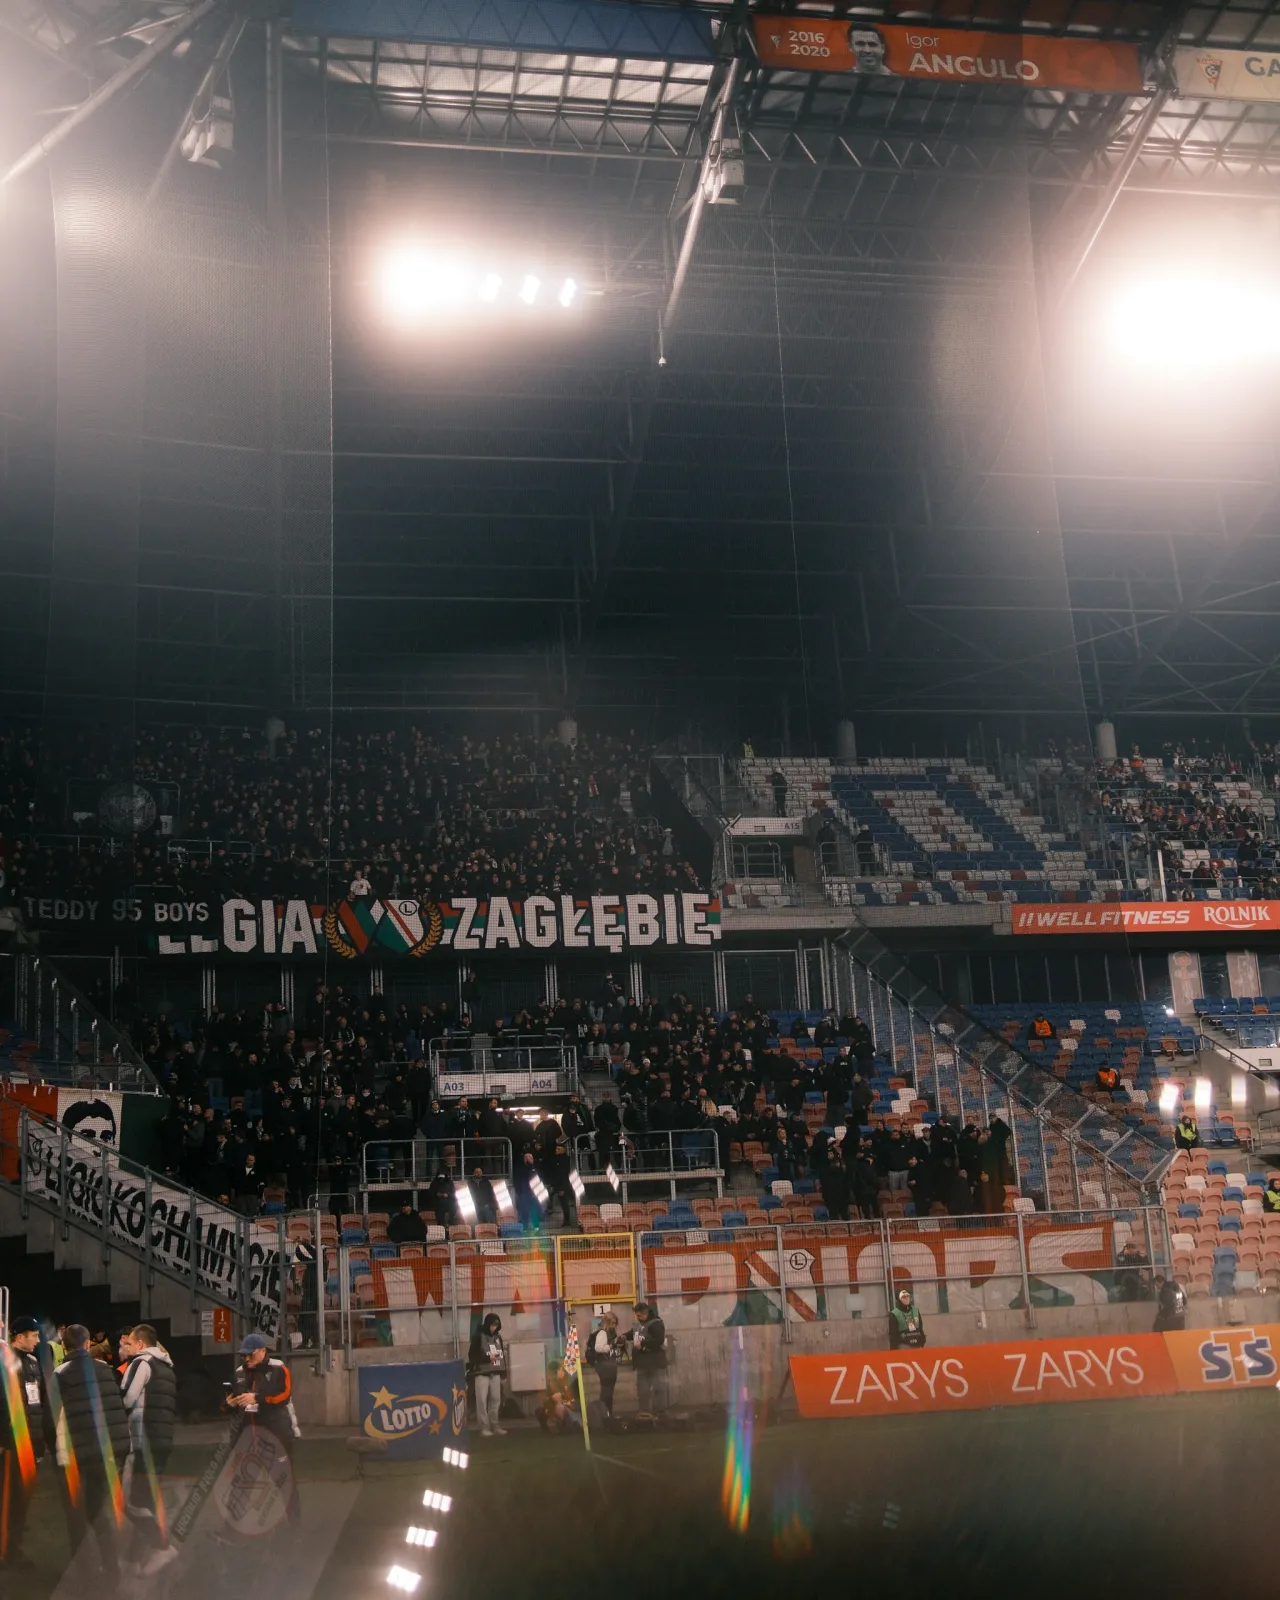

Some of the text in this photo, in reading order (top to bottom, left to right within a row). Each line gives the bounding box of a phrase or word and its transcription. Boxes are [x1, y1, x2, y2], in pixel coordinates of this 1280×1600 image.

[788, 30, 826, 44] 2016
[905, 32, 940, 49] Igor
[790, 44, 831, 58] 2020
[908, 53, 1040, 82] ANGULO
[1244, 56, 1280, 78] GA
[23, 897, 209, 923] TEDDY 95 BOYS
[1099, 909, 1190, 926] FITNESS
[1203, 905, 1271, 925] ROLNIK
[450, 892, 712, 954] ZAGŁĘBIE
[443, 1082, 465, 1092] A03
[532, 1079, 553, 1089] A04
[599, 1305, 605, 1315] 1
[1198, 1329, 1278, 1385] STS
[823, 1346, 1145, 1405] ZARYS ZARYS
[380, 1402, 431, 1431] LOTTO
